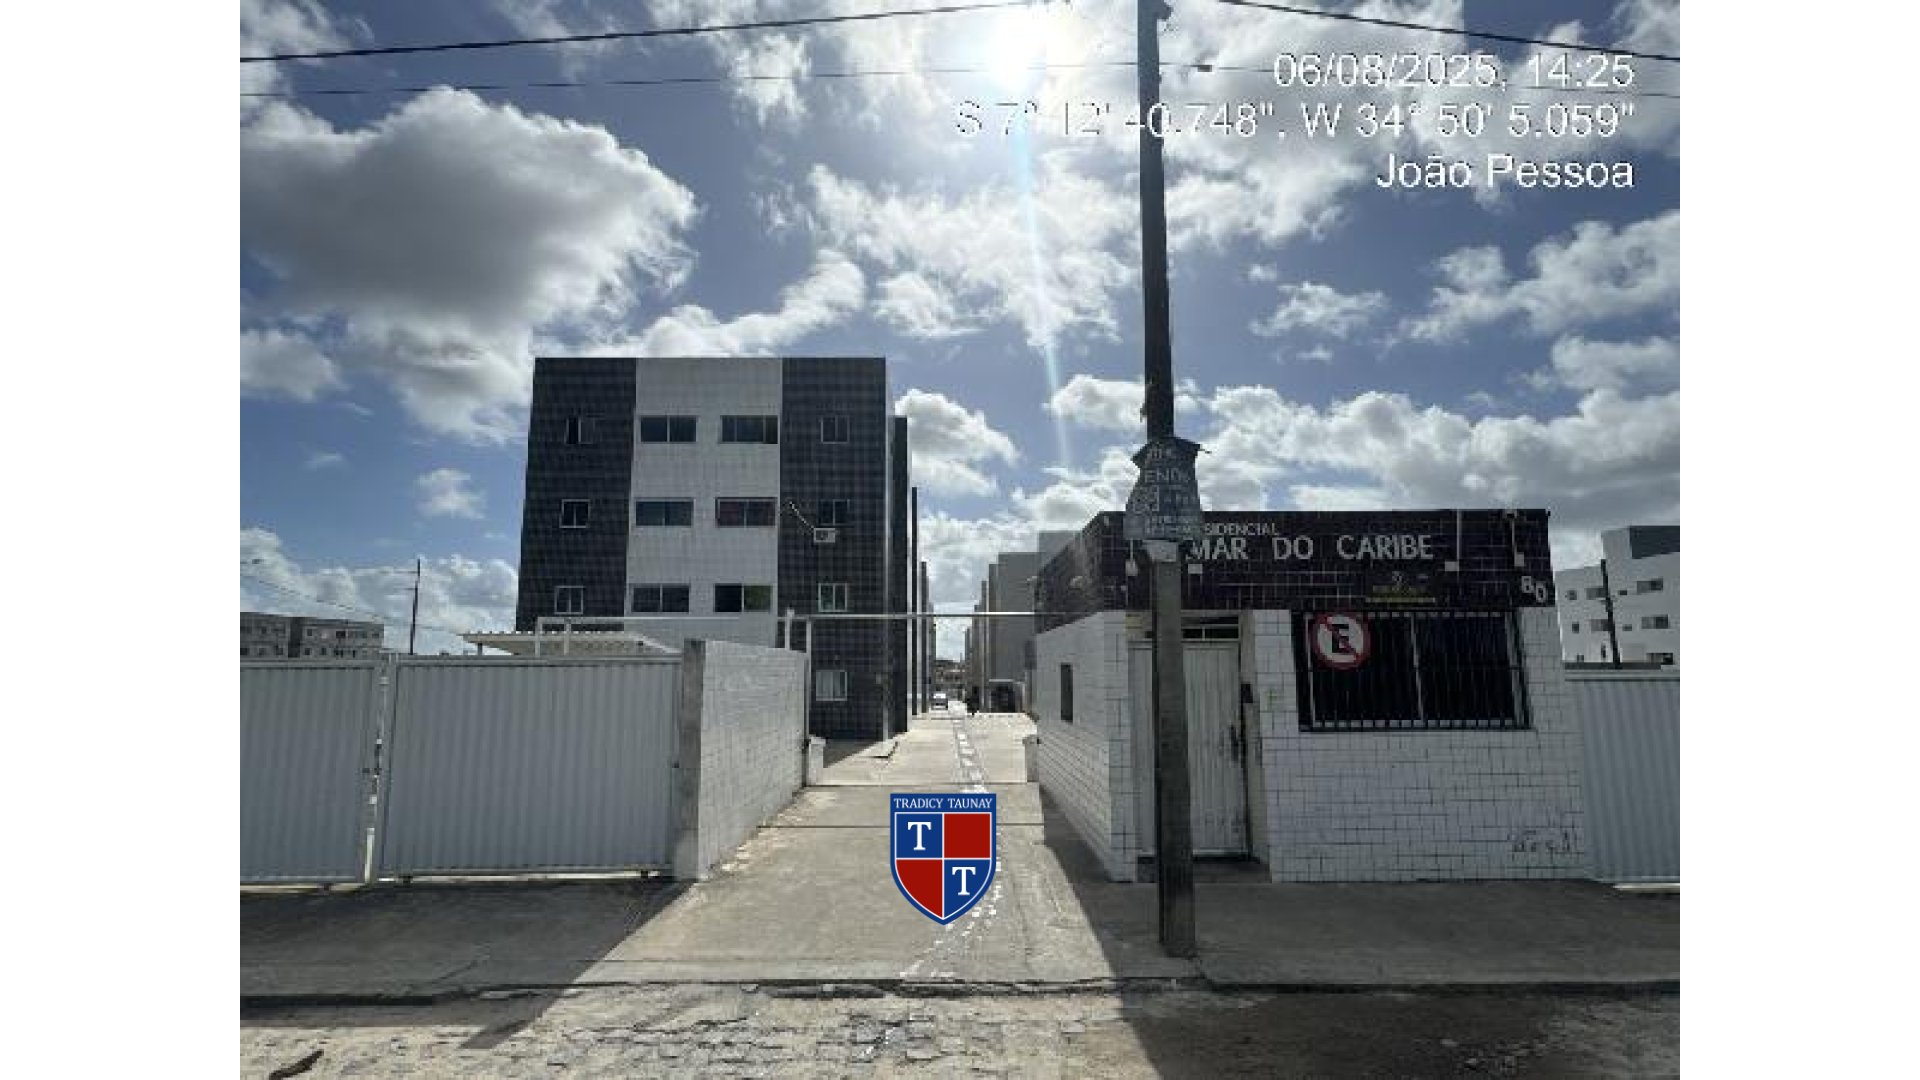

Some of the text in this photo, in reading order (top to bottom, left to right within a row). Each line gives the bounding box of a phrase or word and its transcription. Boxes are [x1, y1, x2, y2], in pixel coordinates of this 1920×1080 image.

[1185, 534, 1434, 560] MAR DO CARIBE
[1331, 623, 1357, 654] E
